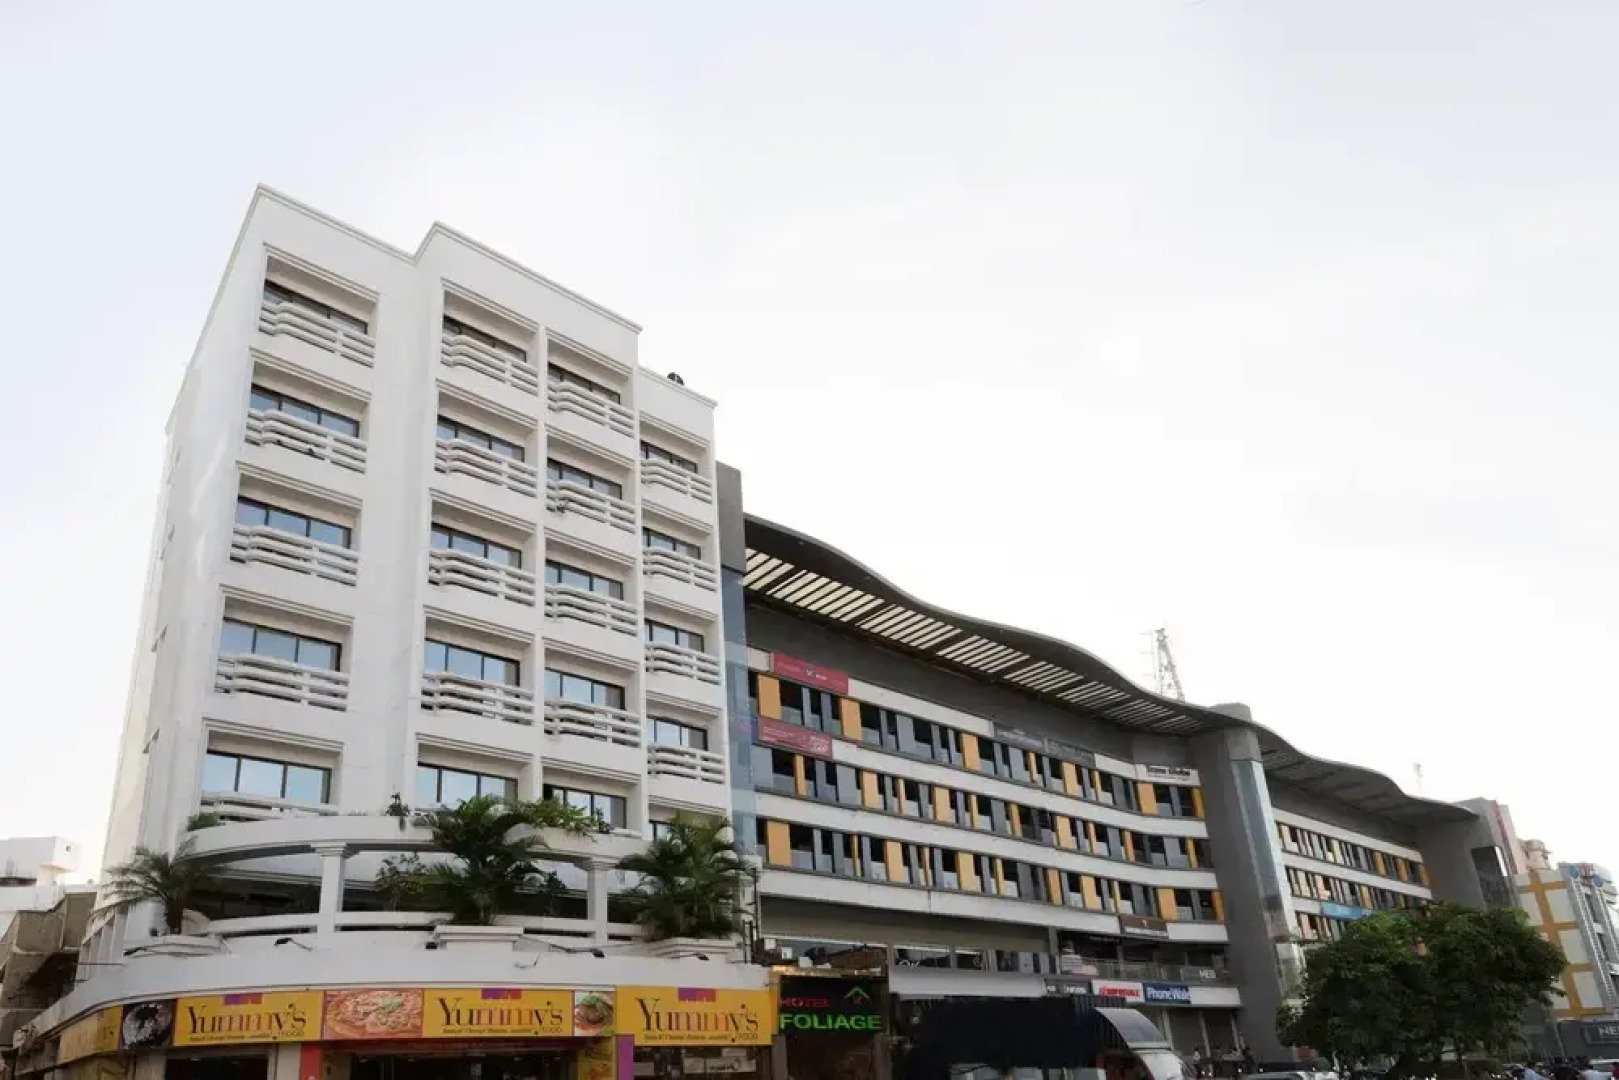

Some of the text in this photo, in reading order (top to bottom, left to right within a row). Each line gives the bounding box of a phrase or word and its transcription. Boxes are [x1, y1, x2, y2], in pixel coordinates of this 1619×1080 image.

[186, 1002, 307, 1041] Yummy's
[435, 996, 563, 1036] Yummy's
[635, 997, 759, 1043] Yummy's
[780, 997, 830, 1008] HOTEL
[780, 1014, 882, 1030] FOLIAGE
